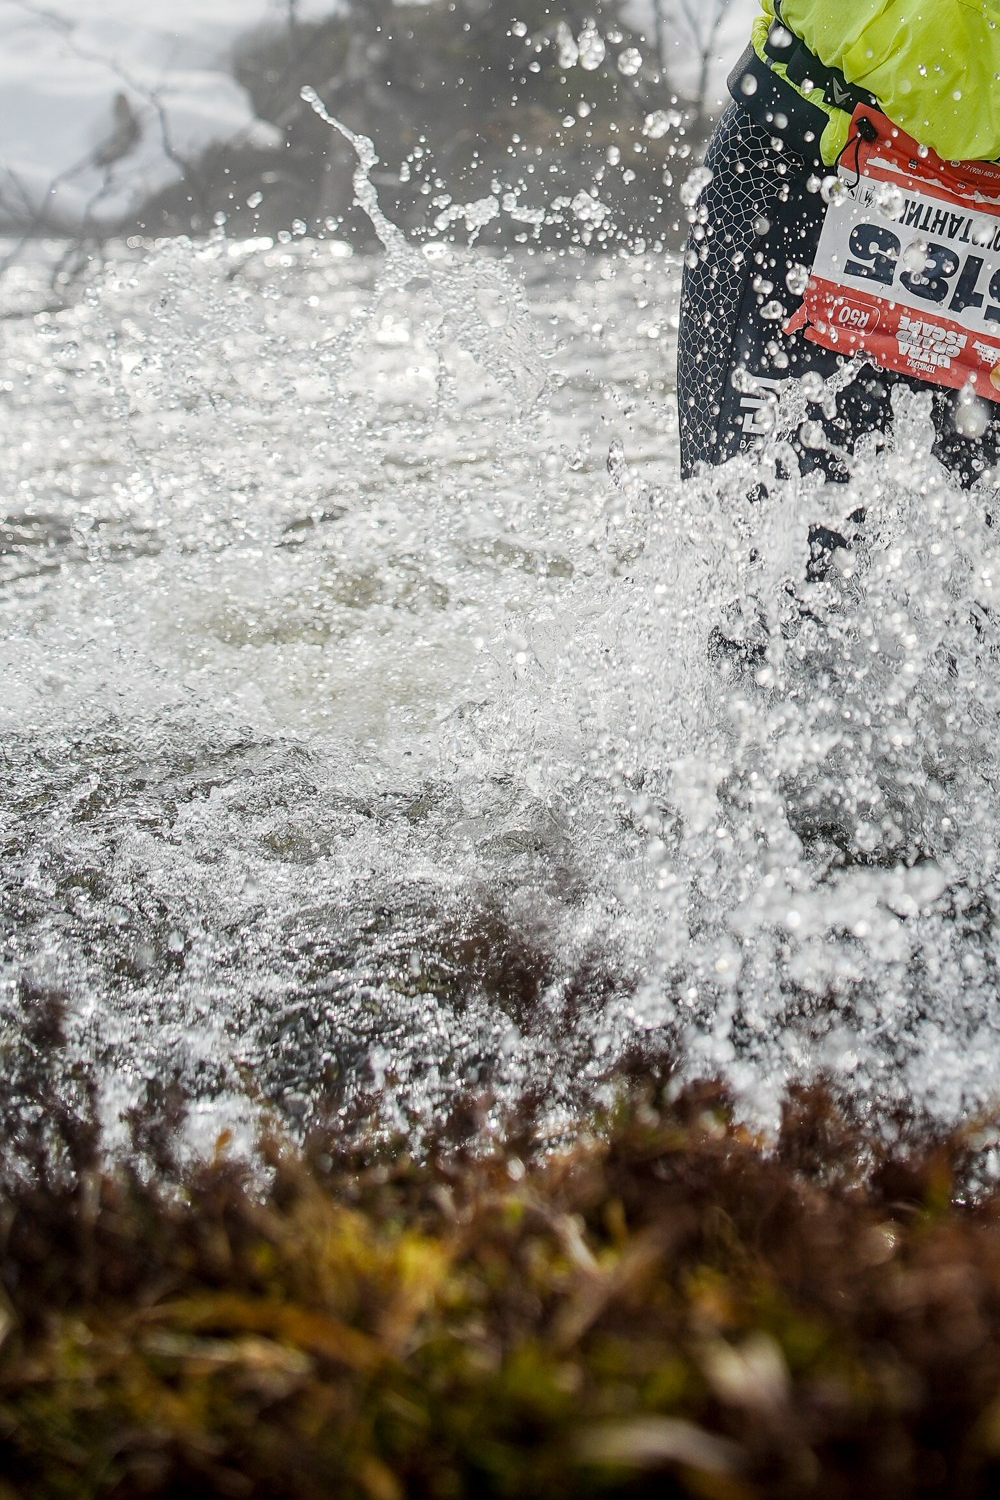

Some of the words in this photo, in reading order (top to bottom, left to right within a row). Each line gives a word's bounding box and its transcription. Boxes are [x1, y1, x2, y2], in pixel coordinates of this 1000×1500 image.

[838, 305, 870, 328] R50
[895, 330, 960, 357] GRAND
[898, 315, 968, 348] ESCAPE
[898, 341, 951, 369] ULTRA
